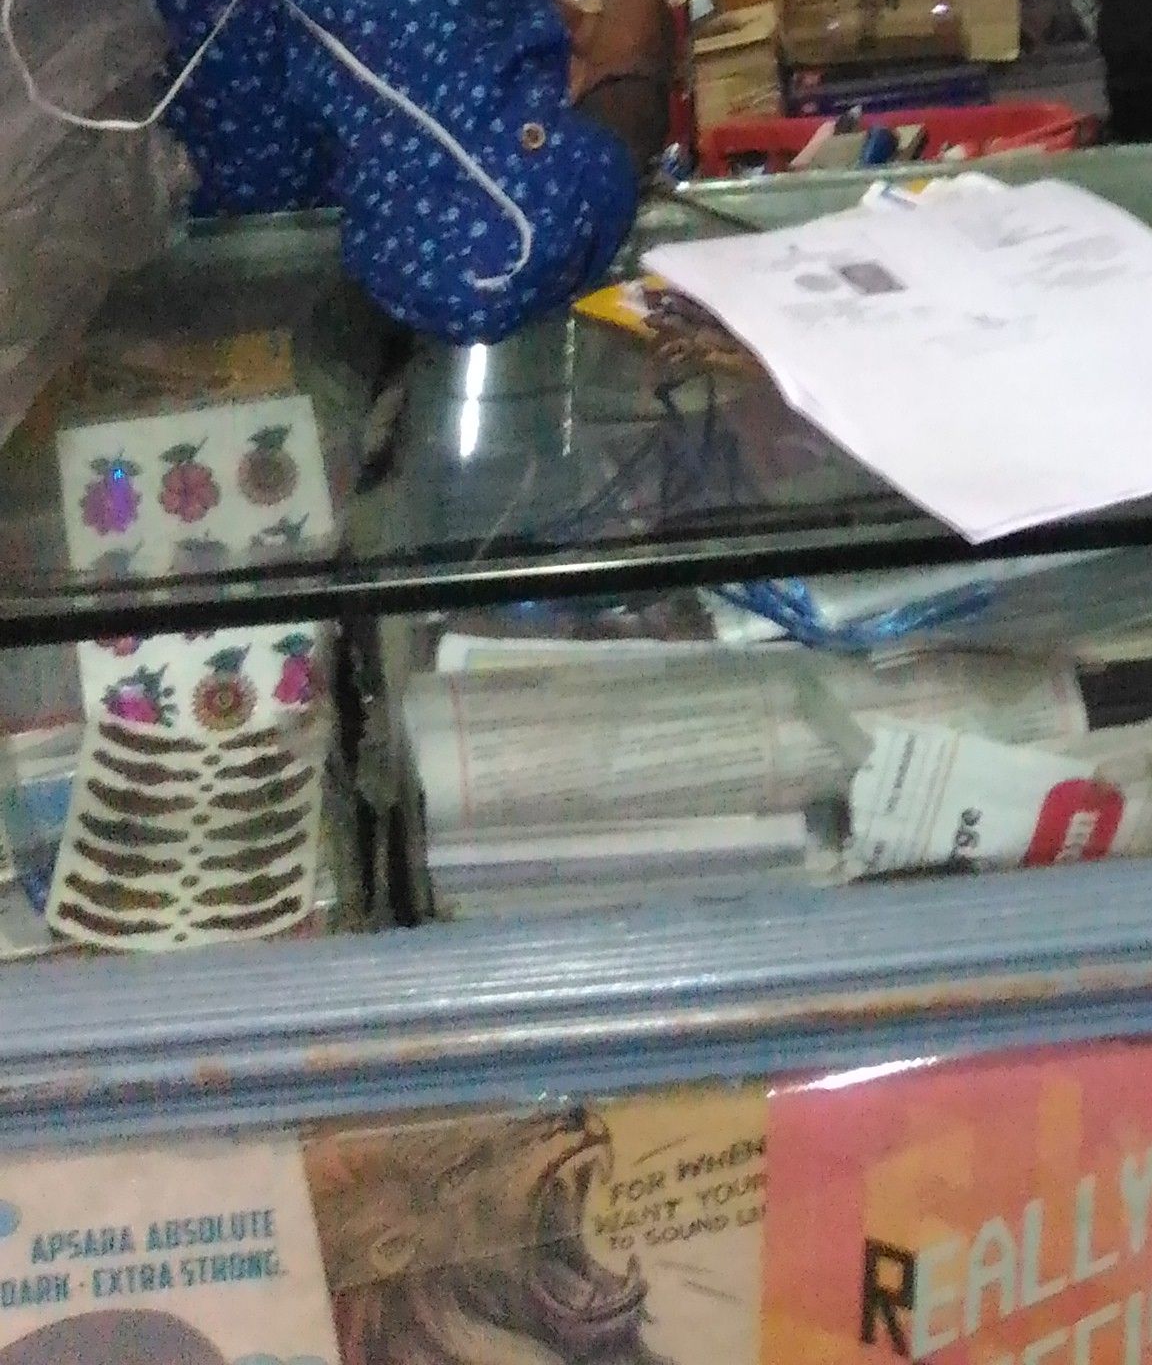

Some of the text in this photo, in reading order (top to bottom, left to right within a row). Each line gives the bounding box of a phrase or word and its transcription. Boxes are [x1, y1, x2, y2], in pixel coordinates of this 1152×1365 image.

[609, 1171, 667, 1207] FOR
[30, 1205, 276, 1266] APSARA ABSOLUTE
[608, 1234, 636, 1252] TO
[643, 1213, 730, 1247] SOUND
[0, 1271, 71, 1309] DARK
[91, 1259, 174, 1298] EXTRA
